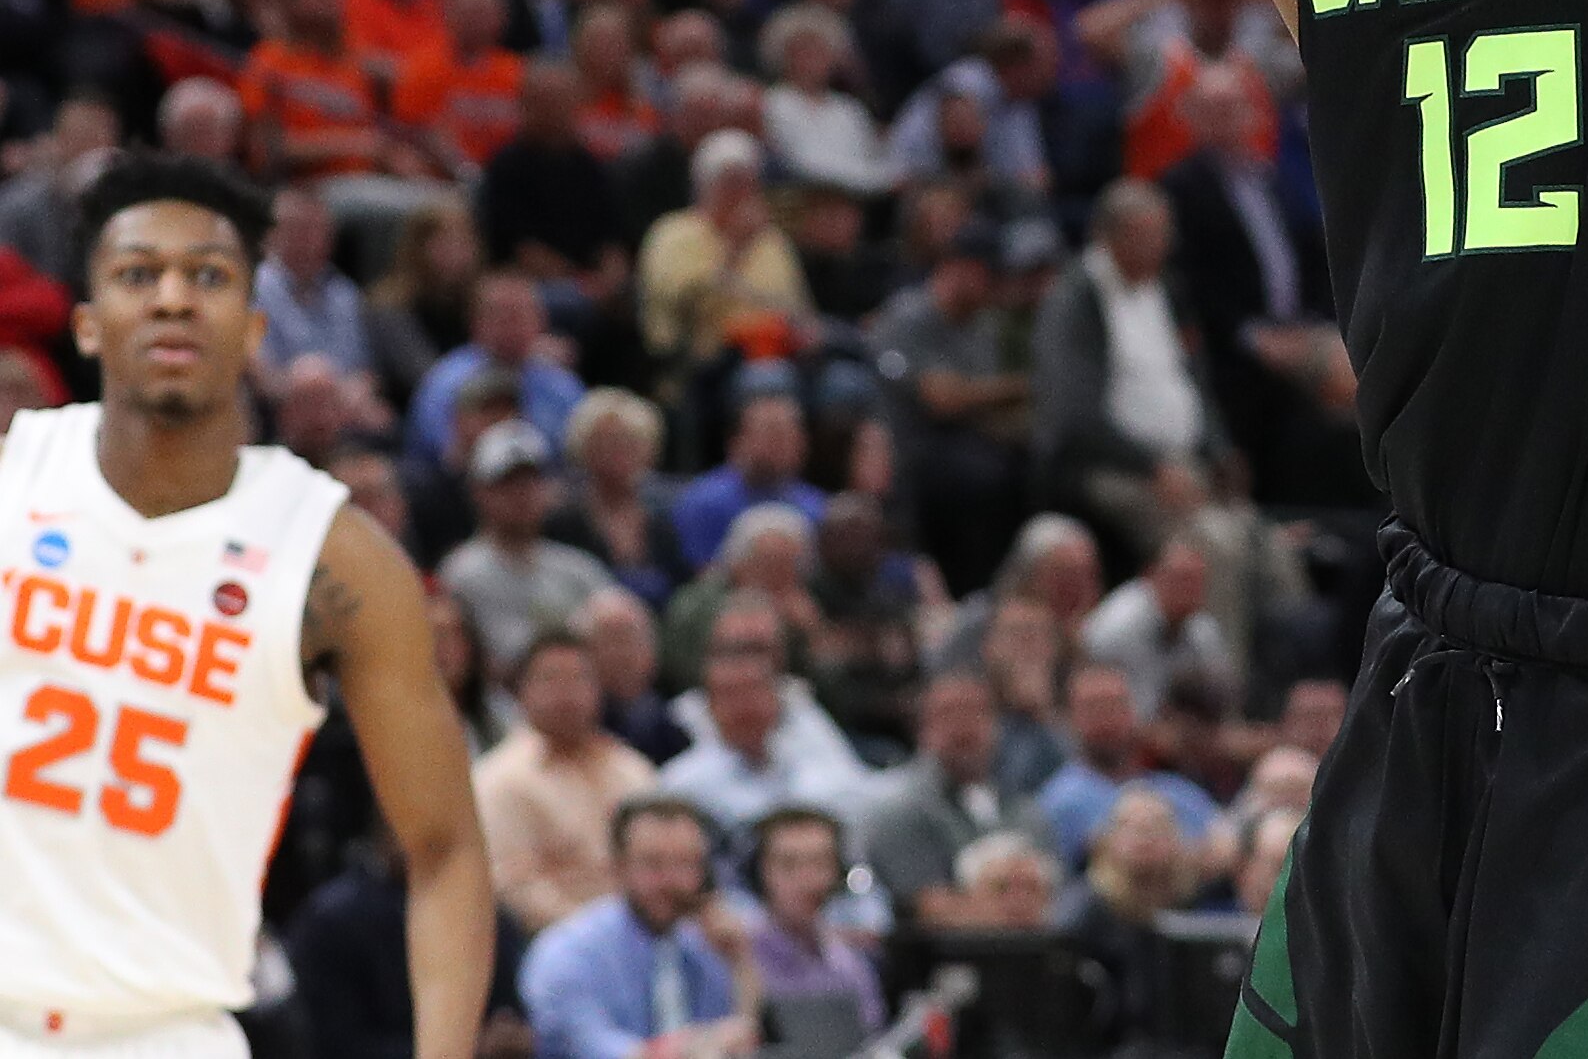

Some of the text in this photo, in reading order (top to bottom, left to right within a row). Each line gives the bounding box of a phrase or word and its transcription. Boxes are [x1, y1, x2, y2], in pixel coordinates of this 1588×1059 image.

[1401, 23, 1584, 262] 12
[2, 567, 250, 707] 'CUSE
[4, 684, 187, 839] 25
